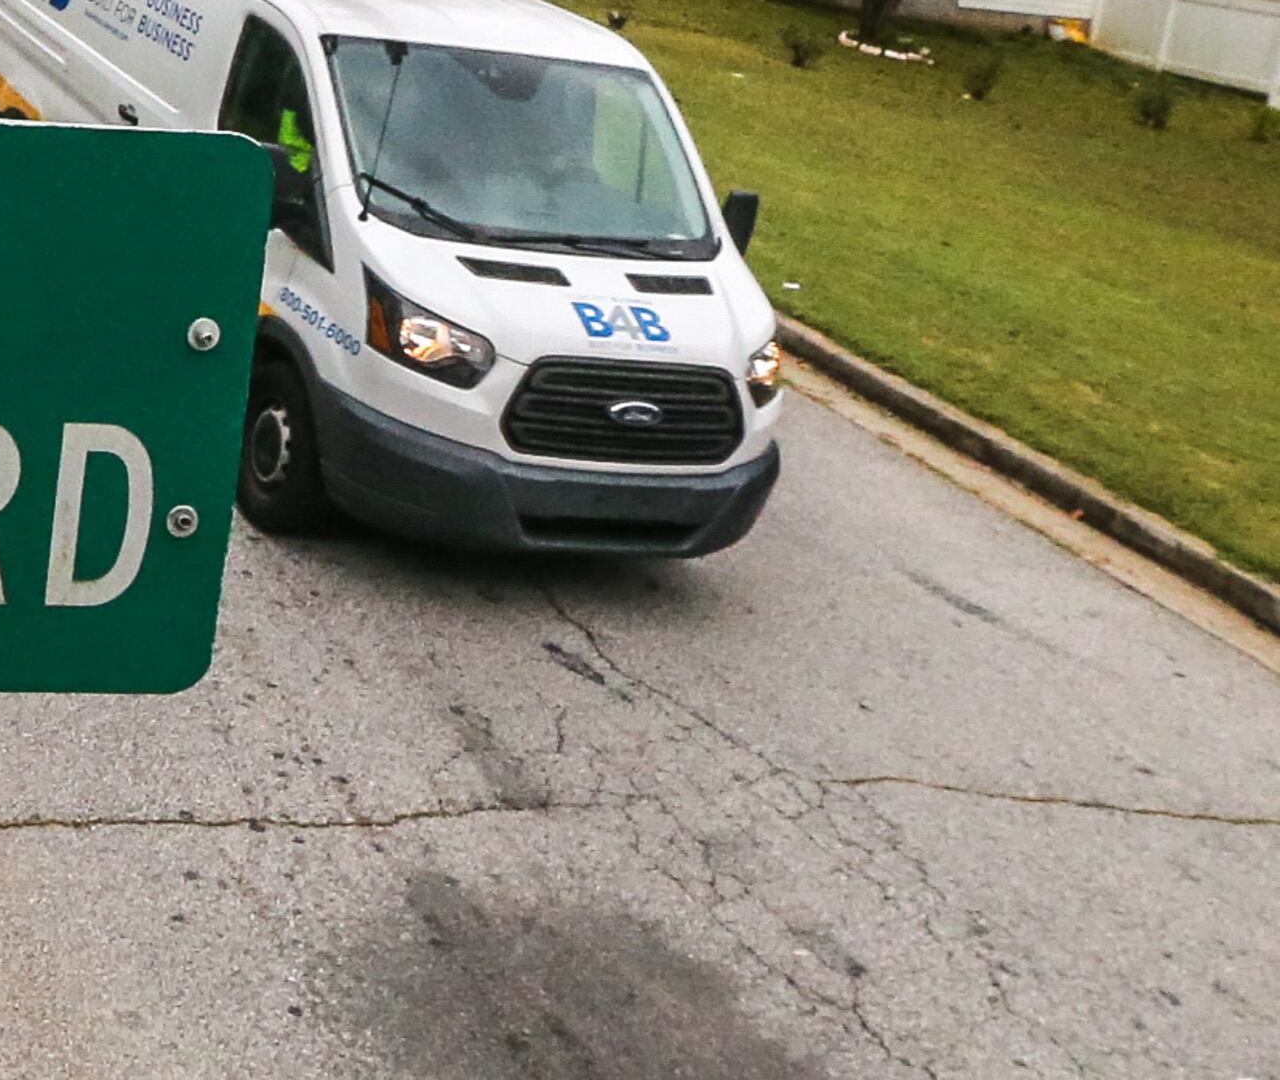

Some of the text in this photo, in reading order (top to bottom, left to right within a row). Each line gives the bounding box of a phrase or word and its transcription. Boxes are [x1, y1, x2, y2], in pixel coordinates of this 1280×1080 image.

[114, 0, 138, 25] FOR
[136, 14, 194, 62] BUSINESS
[280, 286, 361, 356] 800-501-6000
[570, 301, 671, 342] B4B
